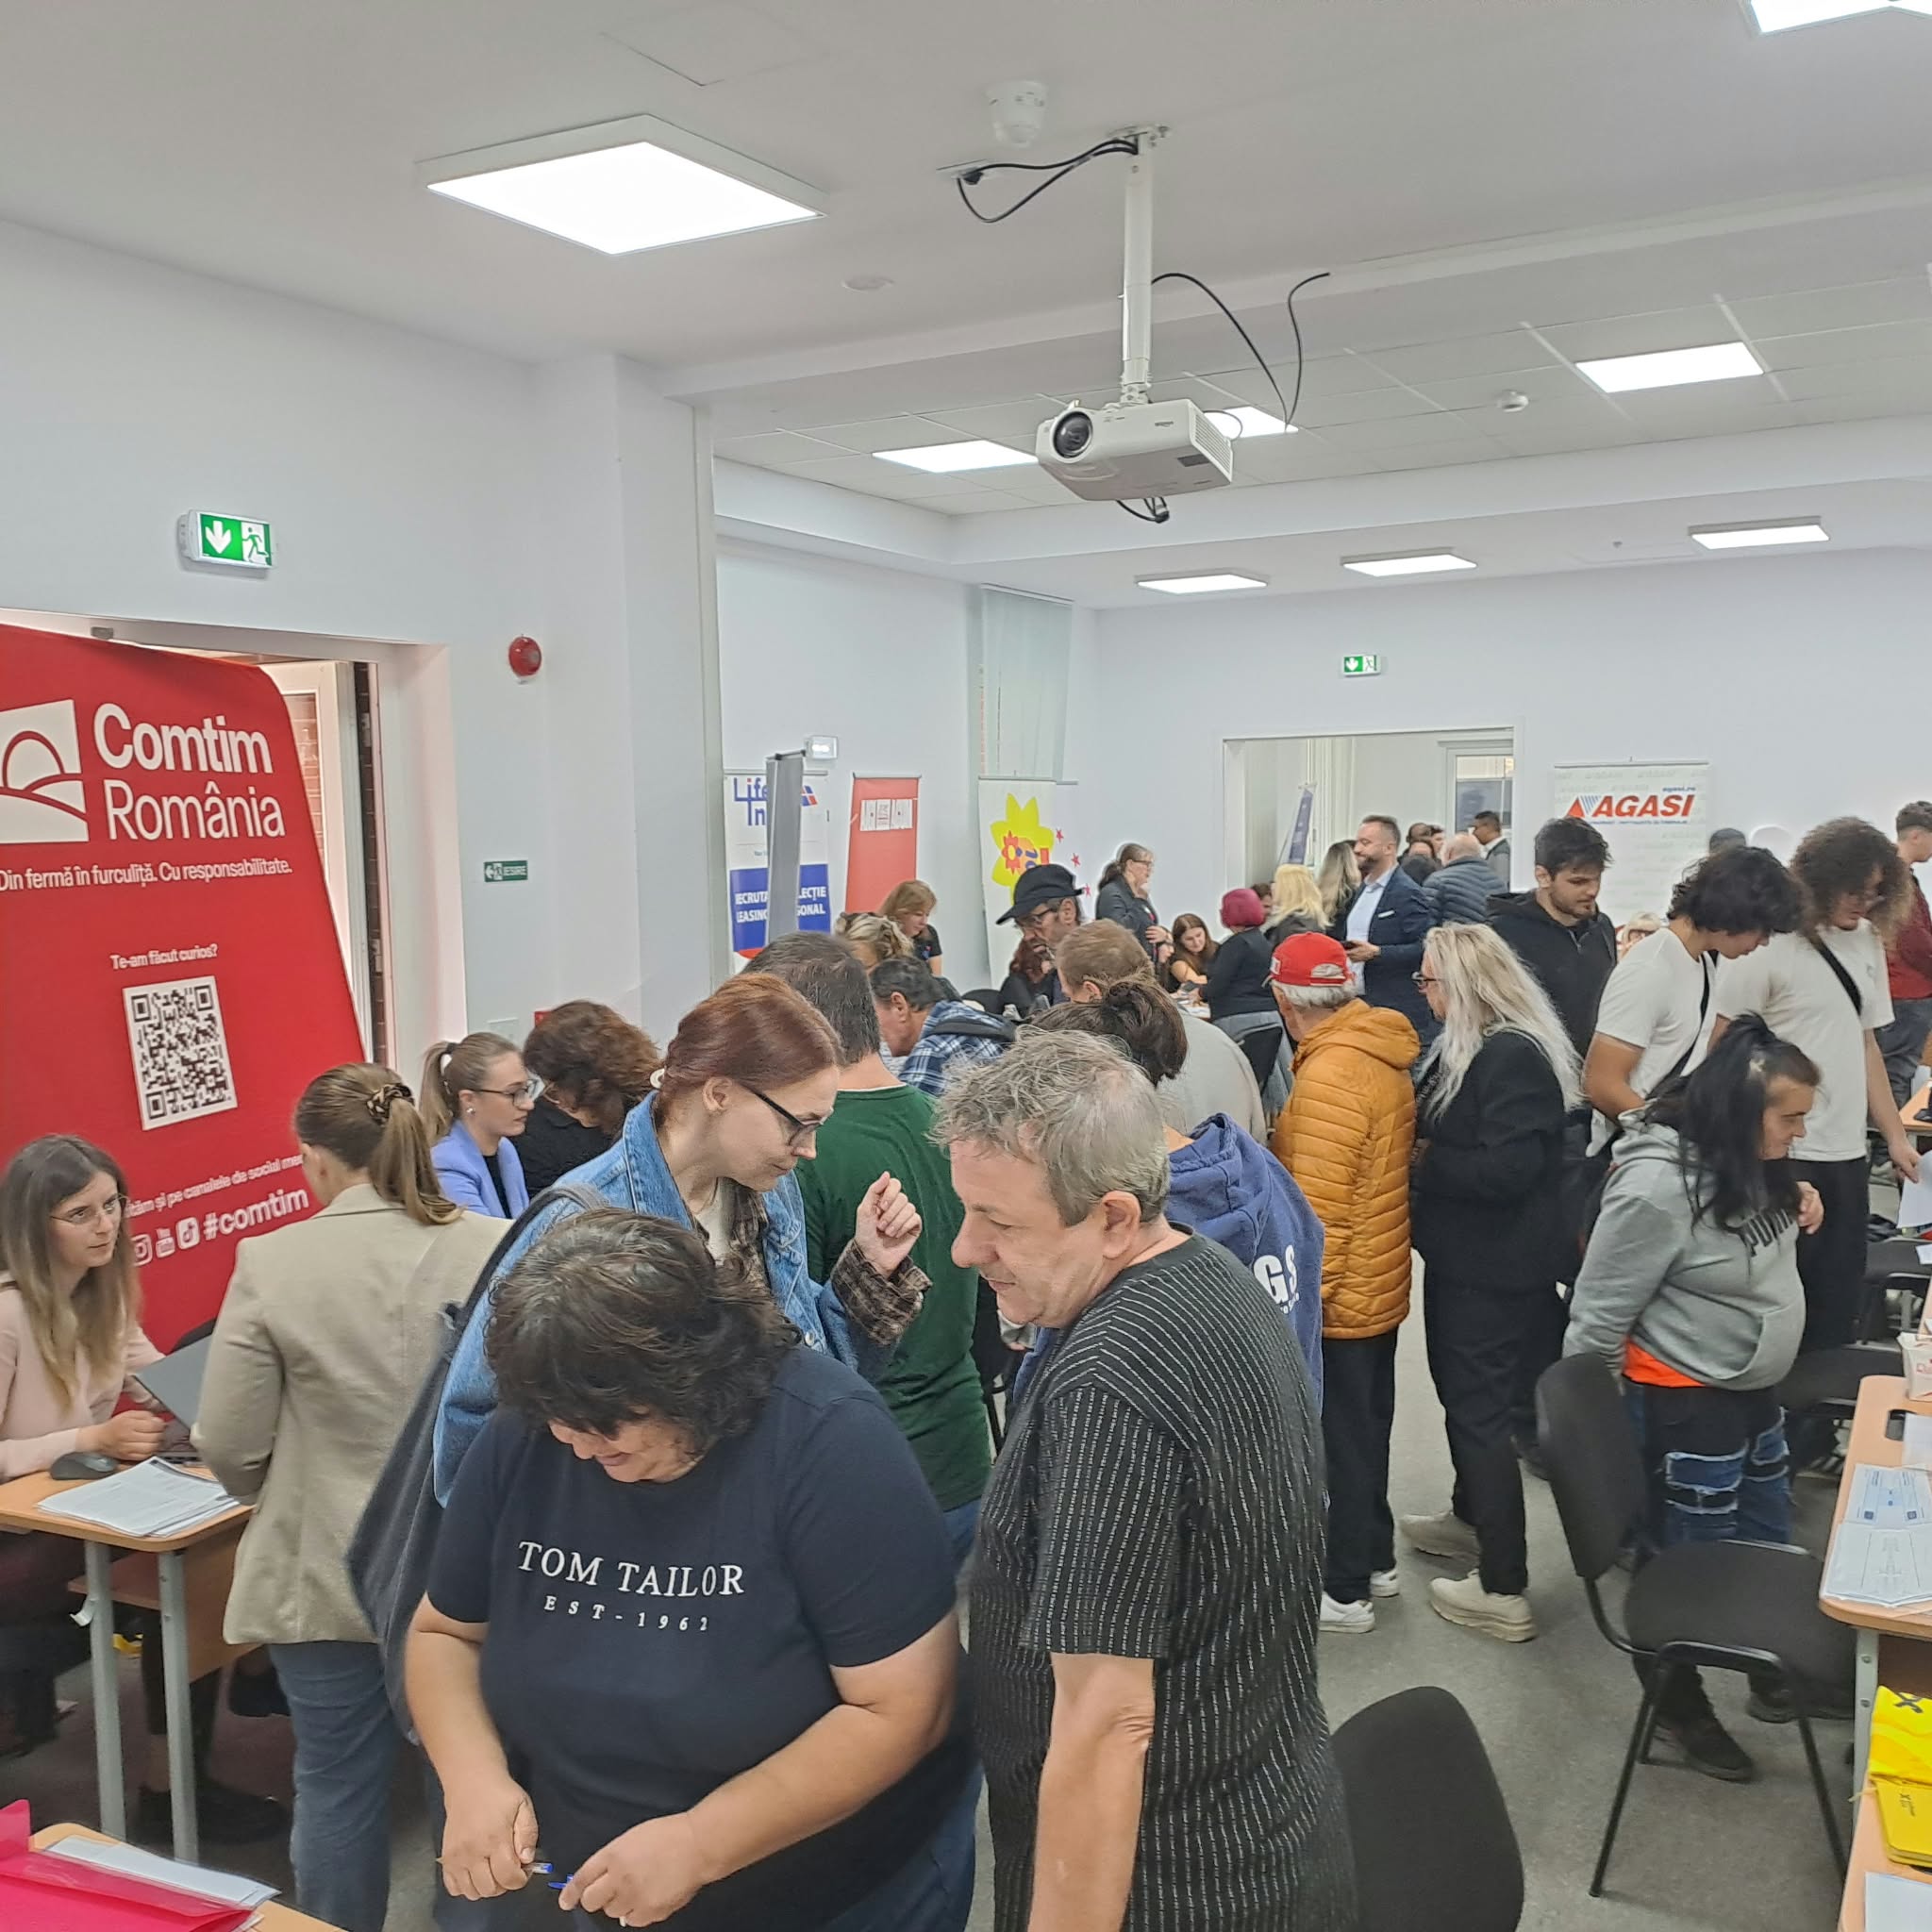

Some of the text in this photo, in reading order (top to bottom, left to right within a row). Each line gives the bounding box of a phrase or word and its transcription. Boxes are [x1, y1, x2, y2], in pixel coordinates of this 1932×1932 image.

[94, 703, 274, 774] Comtim
[103, 780, 286, 841] România
[1591, 794, 1695, 818] AGASI
[0, 857, 292, 891] Din fermă în furculiță. Cu responsabilitate.
[109, 954, 149, 970] Te-am
[178, 942, 218, 961] curios?
[203, 1189, 309, 1241] #comtim
[518, 1541, 744, 1598] TOM TAILOR
